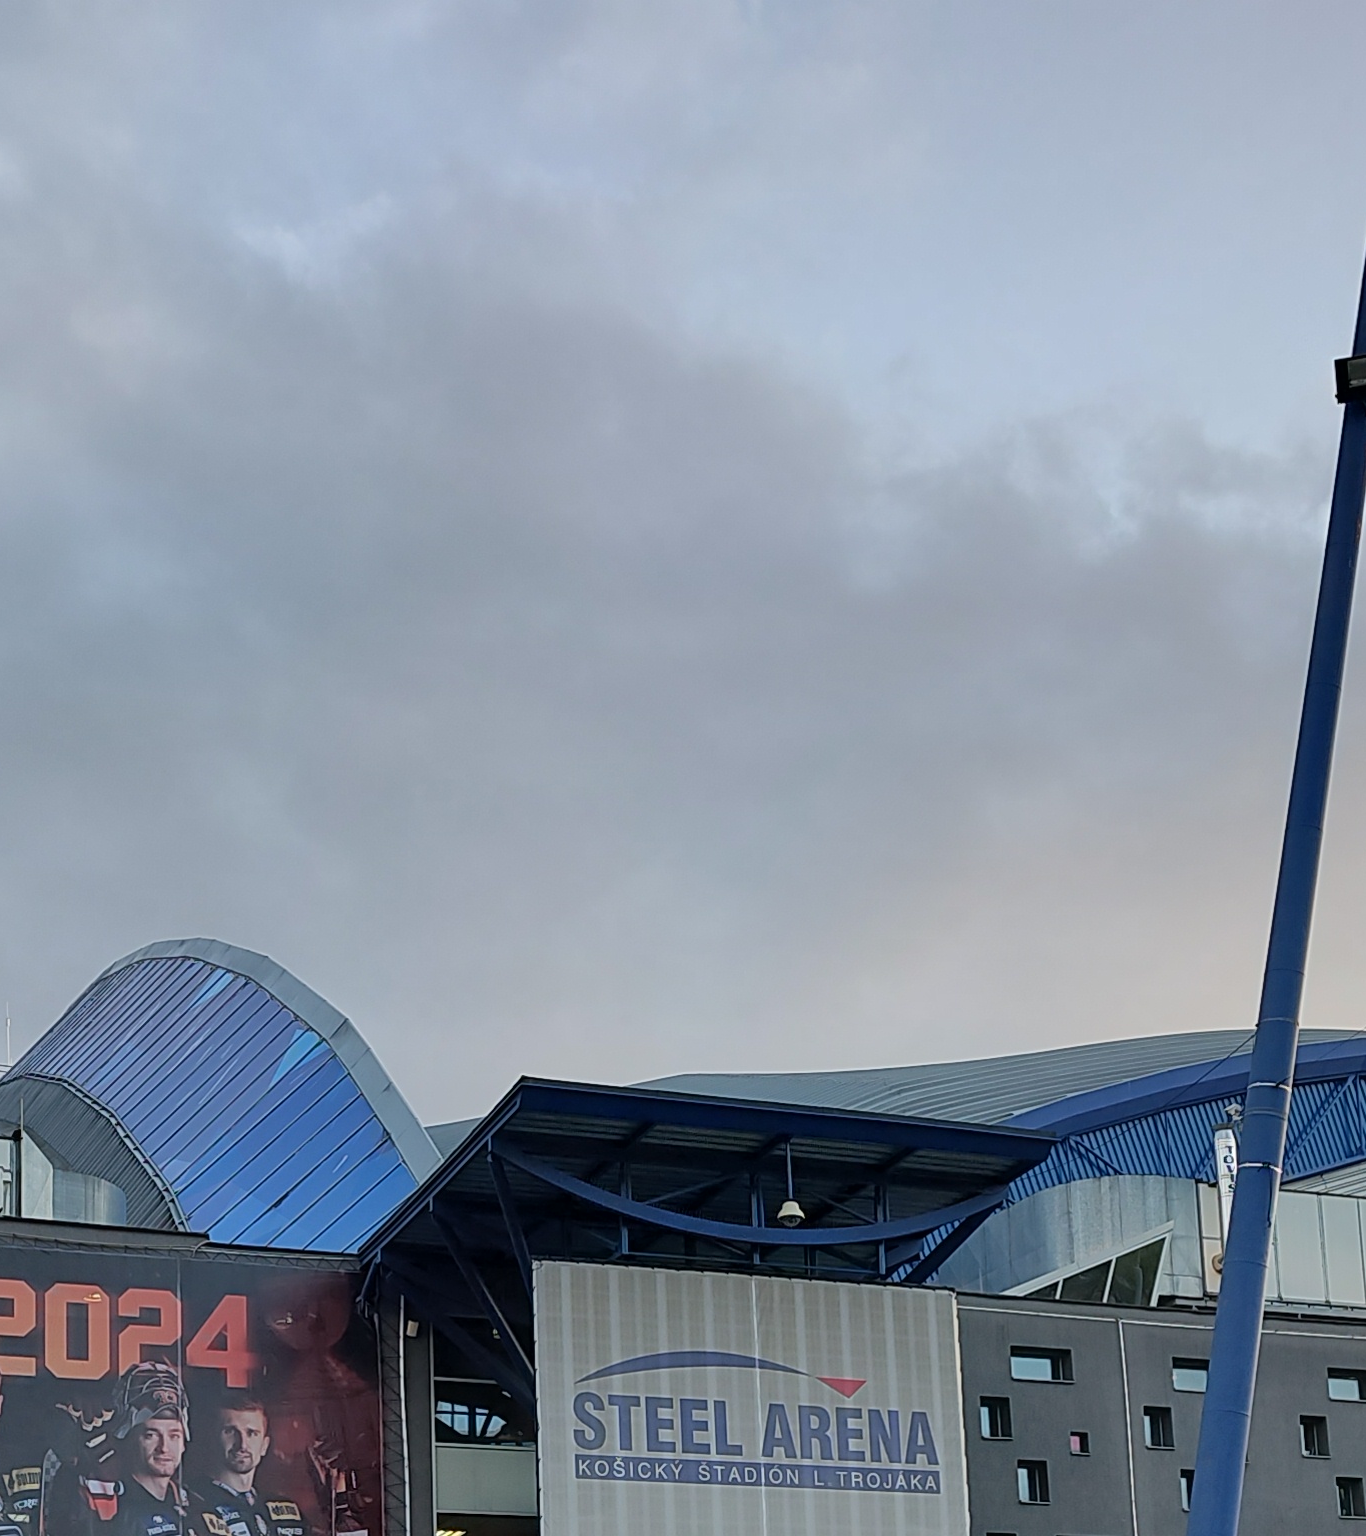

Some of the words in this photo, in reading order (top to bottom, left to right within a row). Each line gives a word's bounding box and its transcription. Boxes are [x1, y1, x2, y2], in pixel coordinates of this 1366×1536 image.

[573, 1391, 743, 1457] STEEL
[761, 1402, 941, 1466] ARENA
[578, 1456, 683, 1481] KOŠICKÝ
[698, 1461, 800, 1486] ŠTADIÓN
[836, 1470, 939, 1491] TROJÁKA
